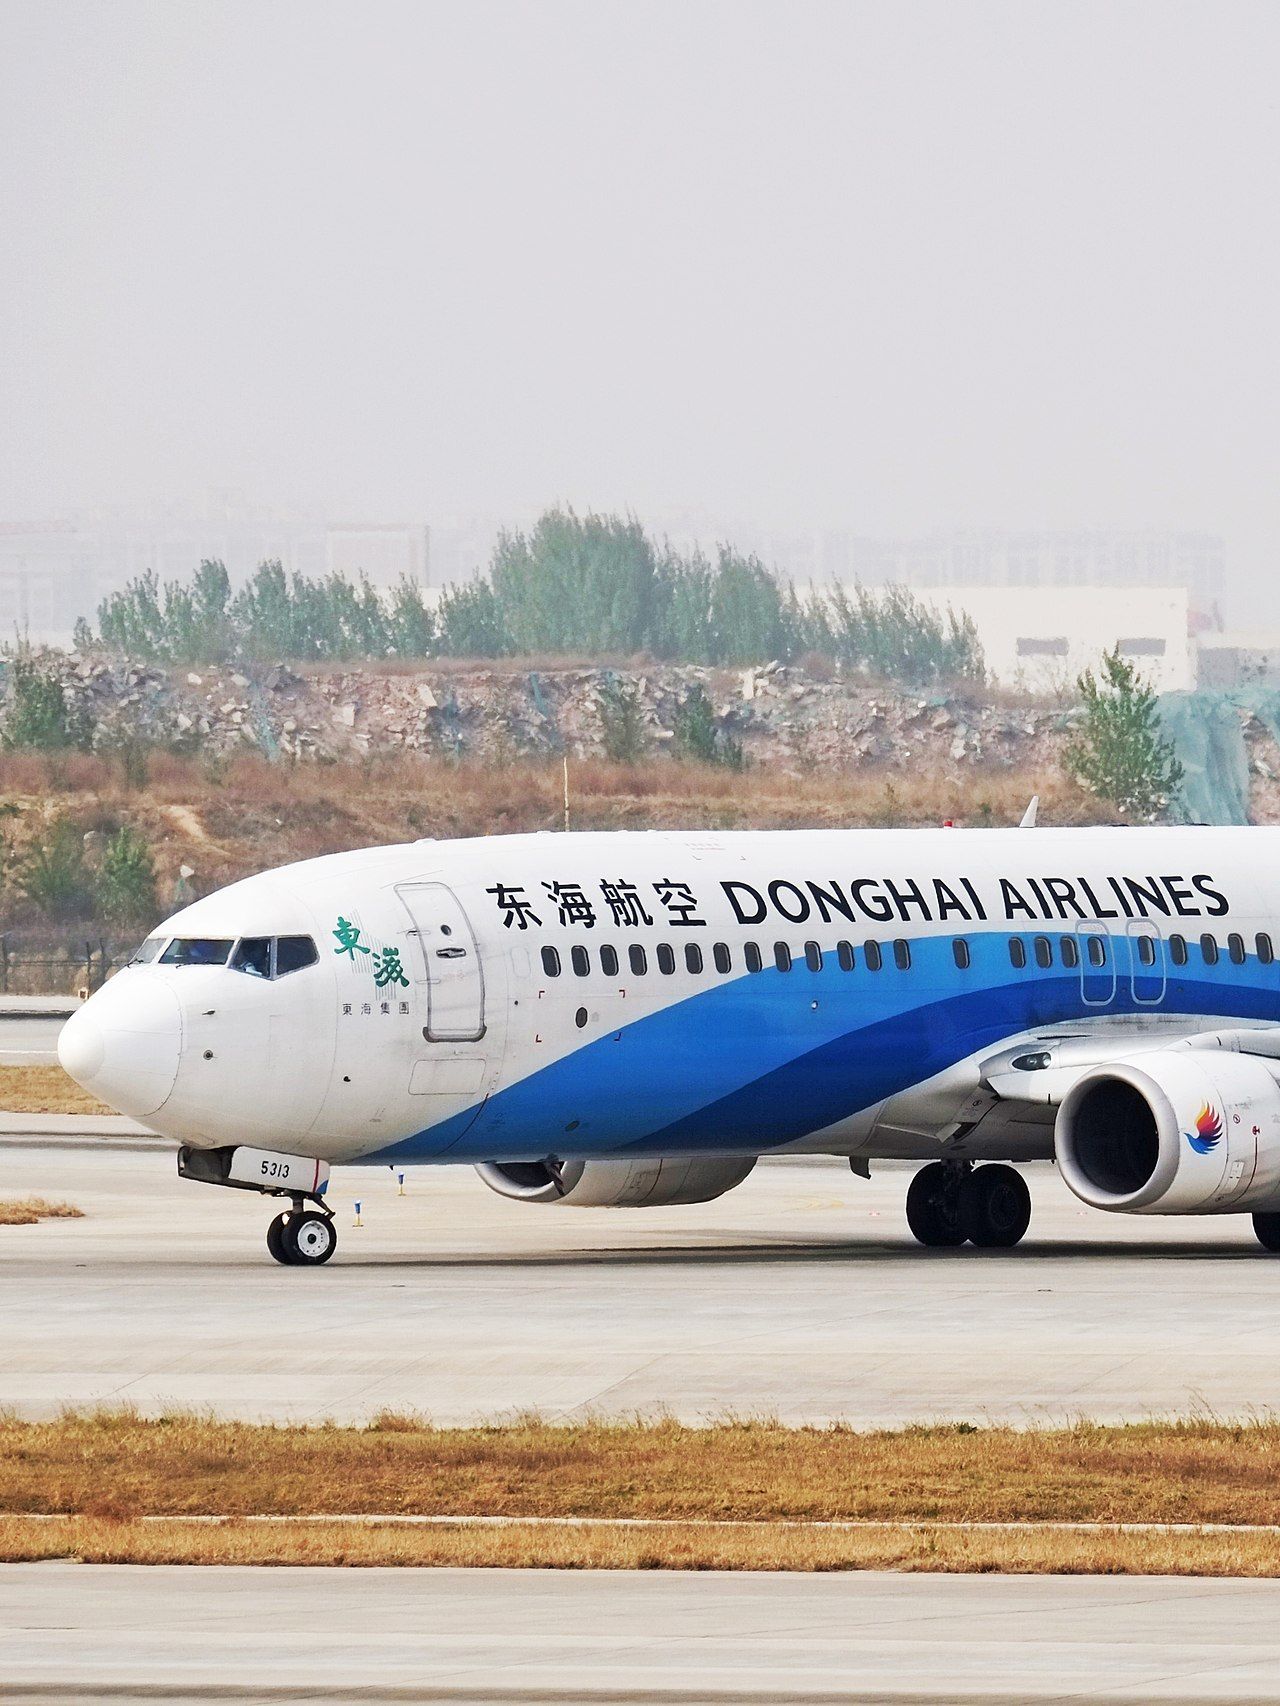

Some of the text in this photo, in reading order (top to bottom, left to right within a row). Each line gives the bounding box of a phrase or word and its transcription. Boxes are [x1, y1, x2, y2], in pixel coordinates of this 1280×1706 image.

[485, 874, 1231, 931] 东海航空 DONGHAI AIRLINES
[261, 1160, 290, 1178] 5313
